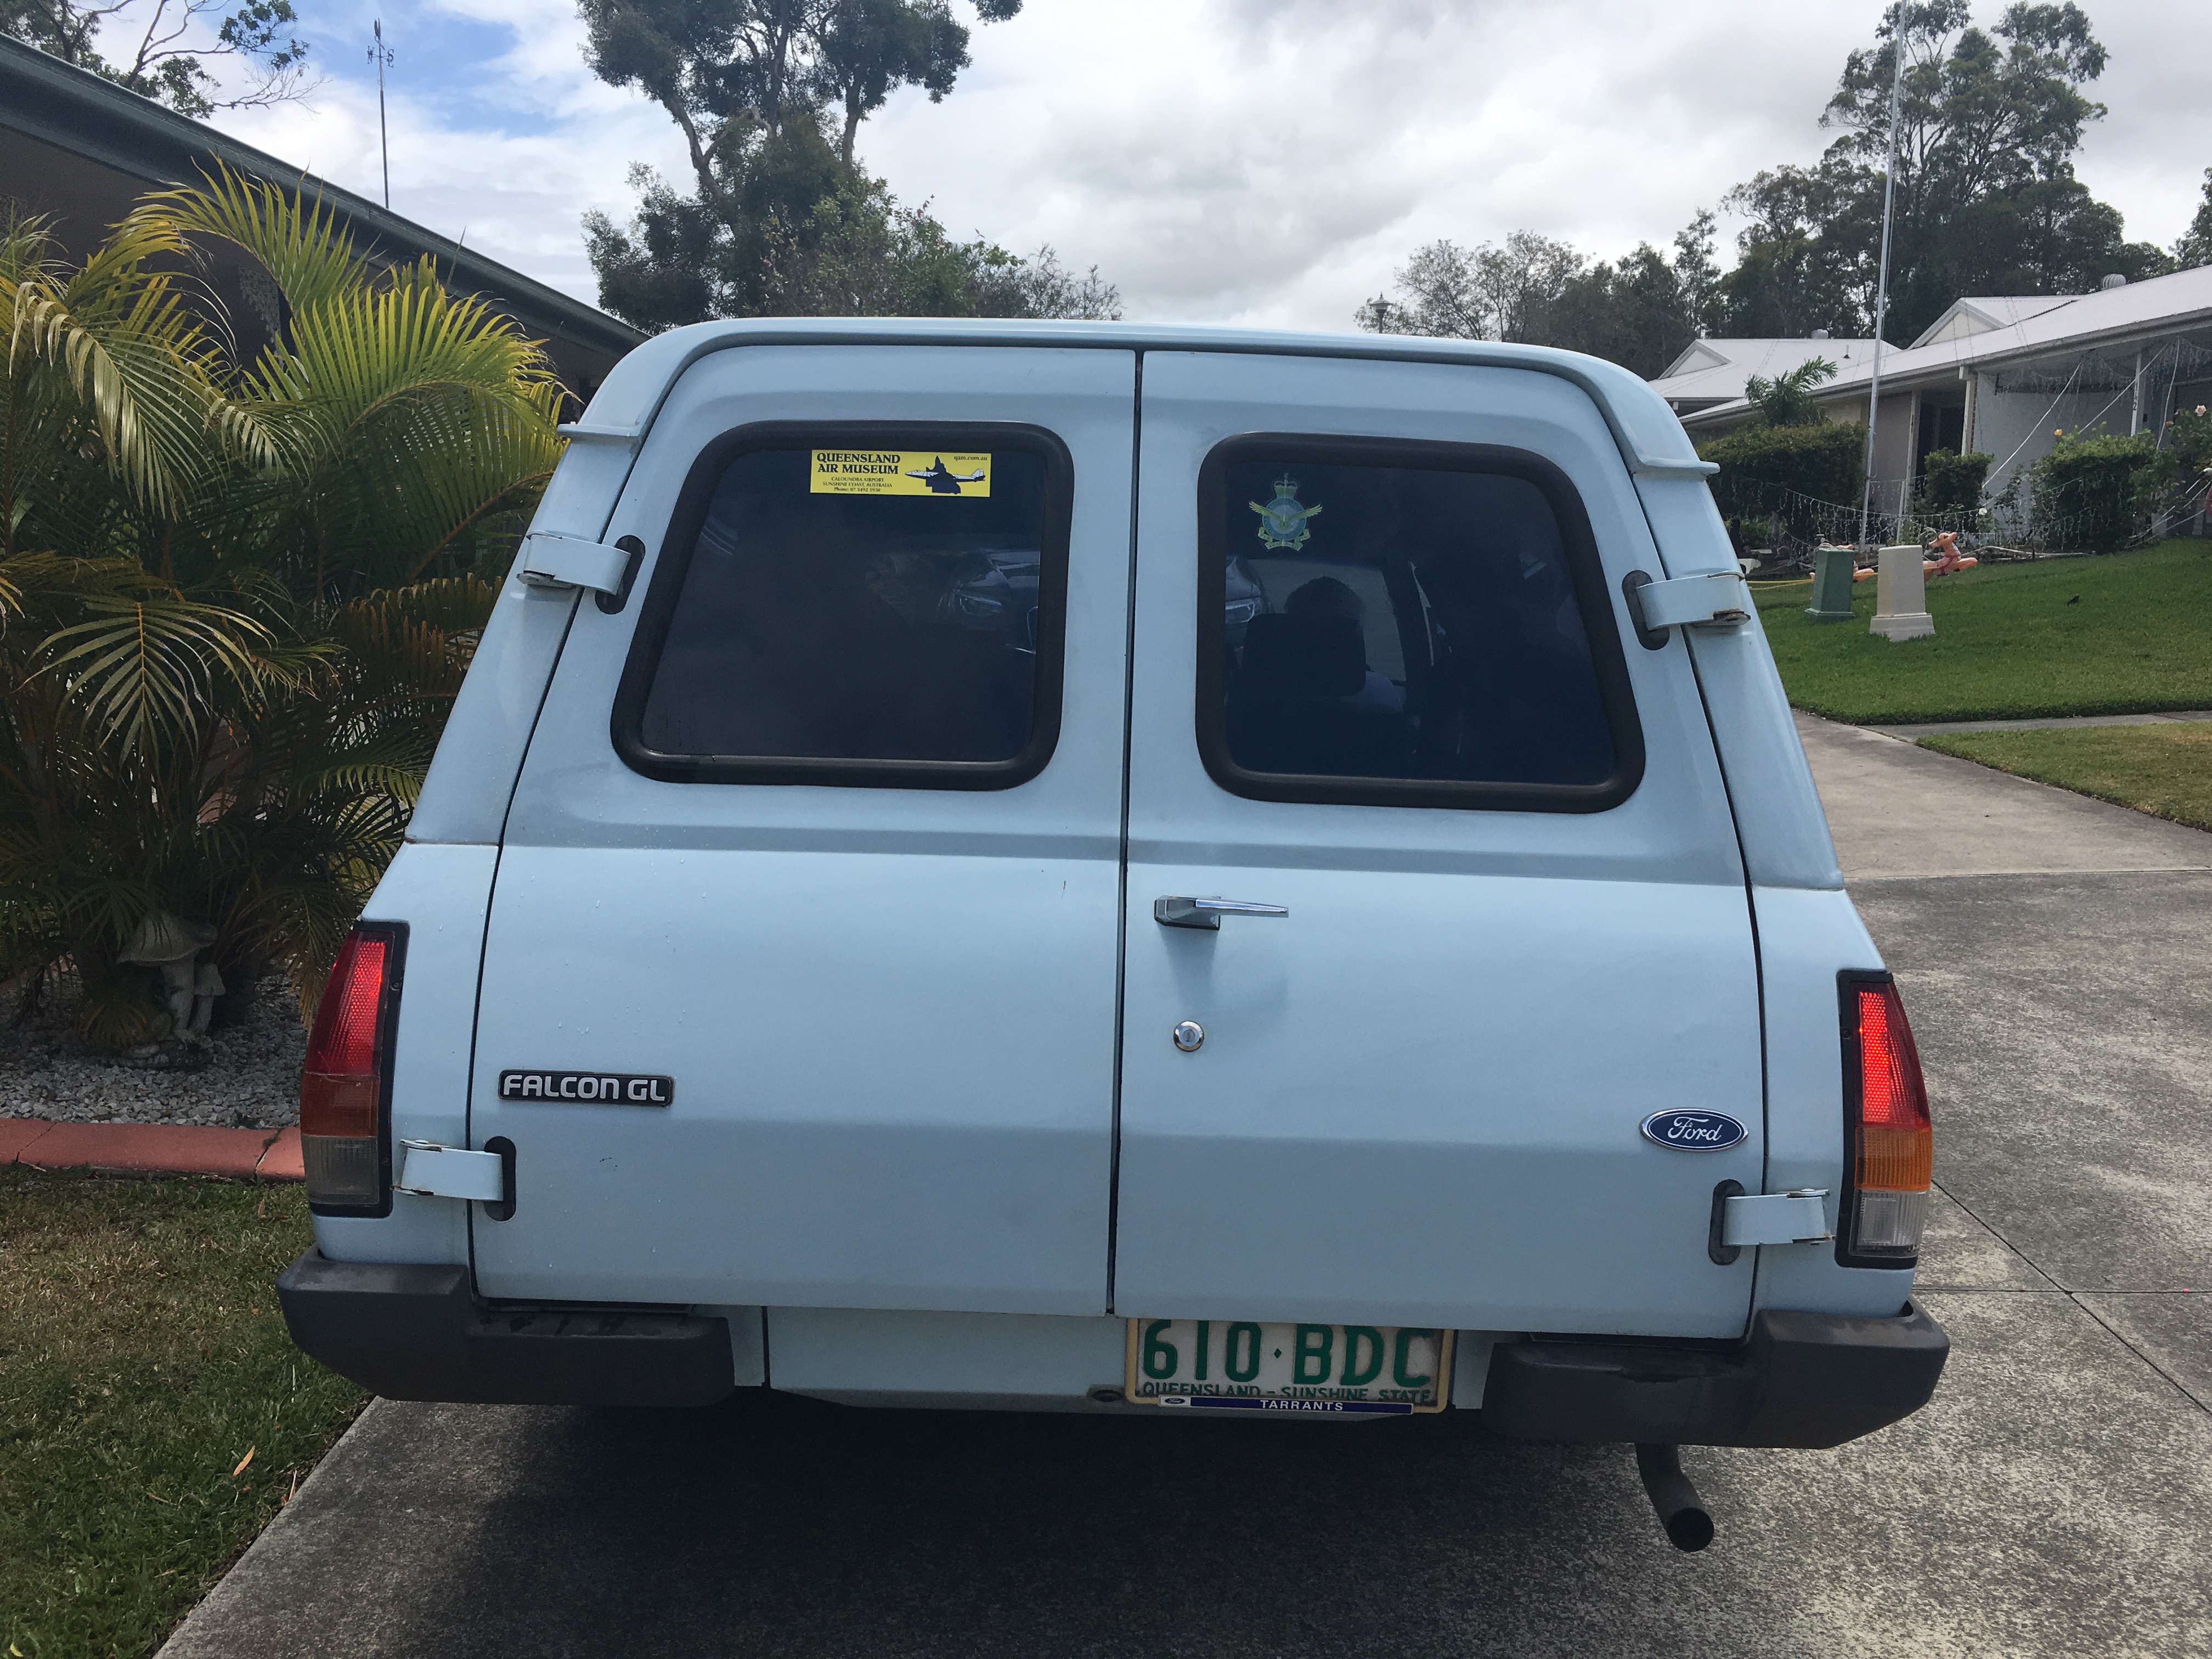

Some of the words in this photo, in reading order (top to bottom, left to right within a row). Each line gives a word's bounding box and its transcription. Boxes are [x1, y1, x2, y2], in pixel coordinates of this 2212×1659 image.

[817, 453, 901, 464] QUEENSLAND
[817, 464, 838, 473] AIR
[842, 464, 899, 474] MUSEUM
[504, 1075, 619, 1099] FALCON
[627, 1079, 665, 1101] GL
[1668, 1116, 1723, 1141] Ford
[1143, 1381, 1261, 1396] QUEENSLAND
[1282, 1386, 1368, 1400] SUNSHINE
[1378, 1389, 1431, 1403] STATE
[1260, 1400, 1344, 1412] TARRANTS
